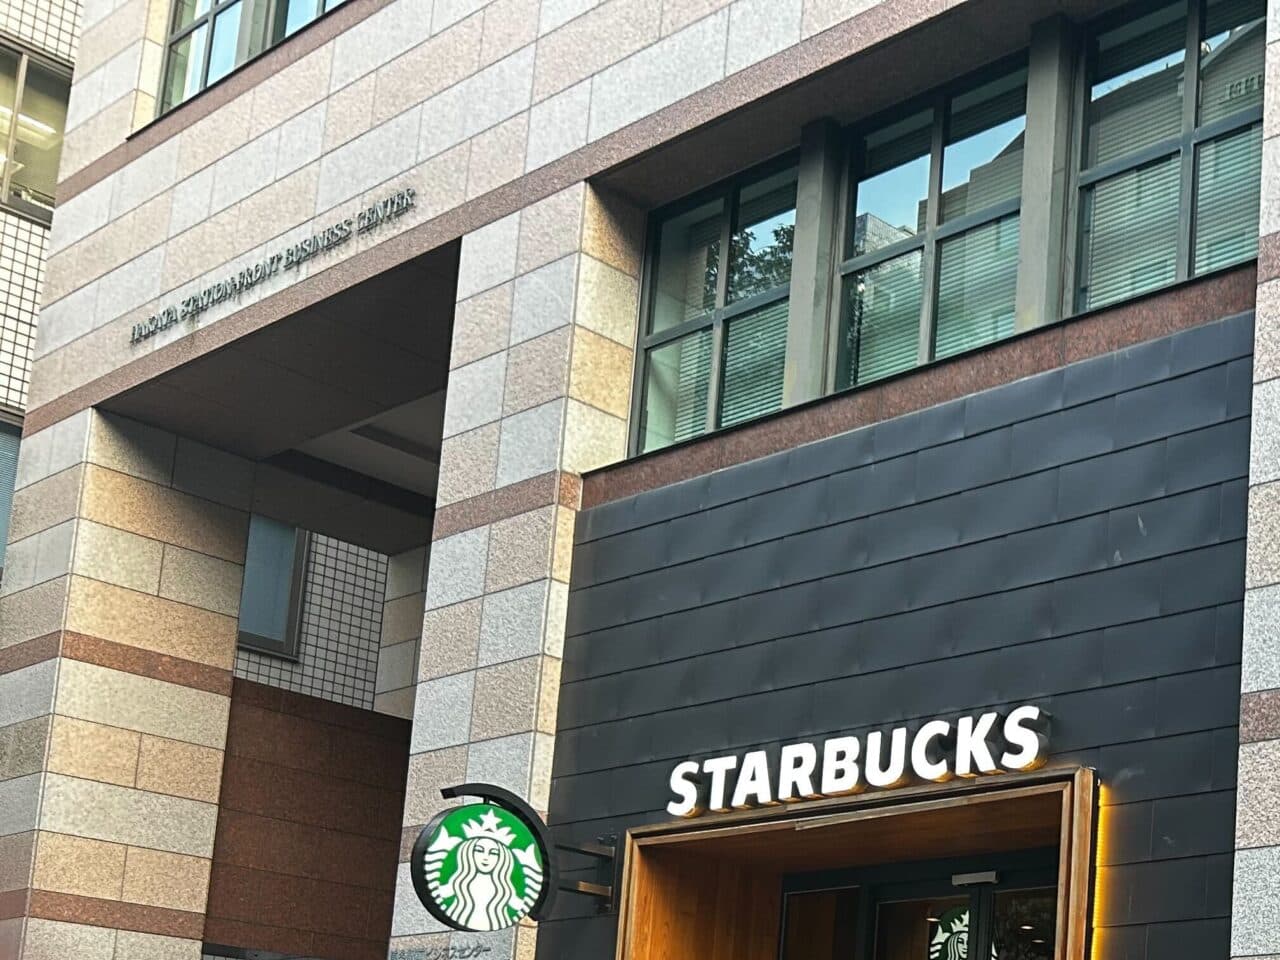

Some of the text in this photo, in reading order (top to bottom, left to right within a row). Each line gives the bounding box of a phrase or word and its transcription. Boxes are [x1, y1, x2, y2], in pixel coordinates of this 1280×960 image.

[283, 218, 353, 271] BUSINESS
[356, 187, 416, 236] CENTER
[666, 704, 1043, 818] STARBUCKS
